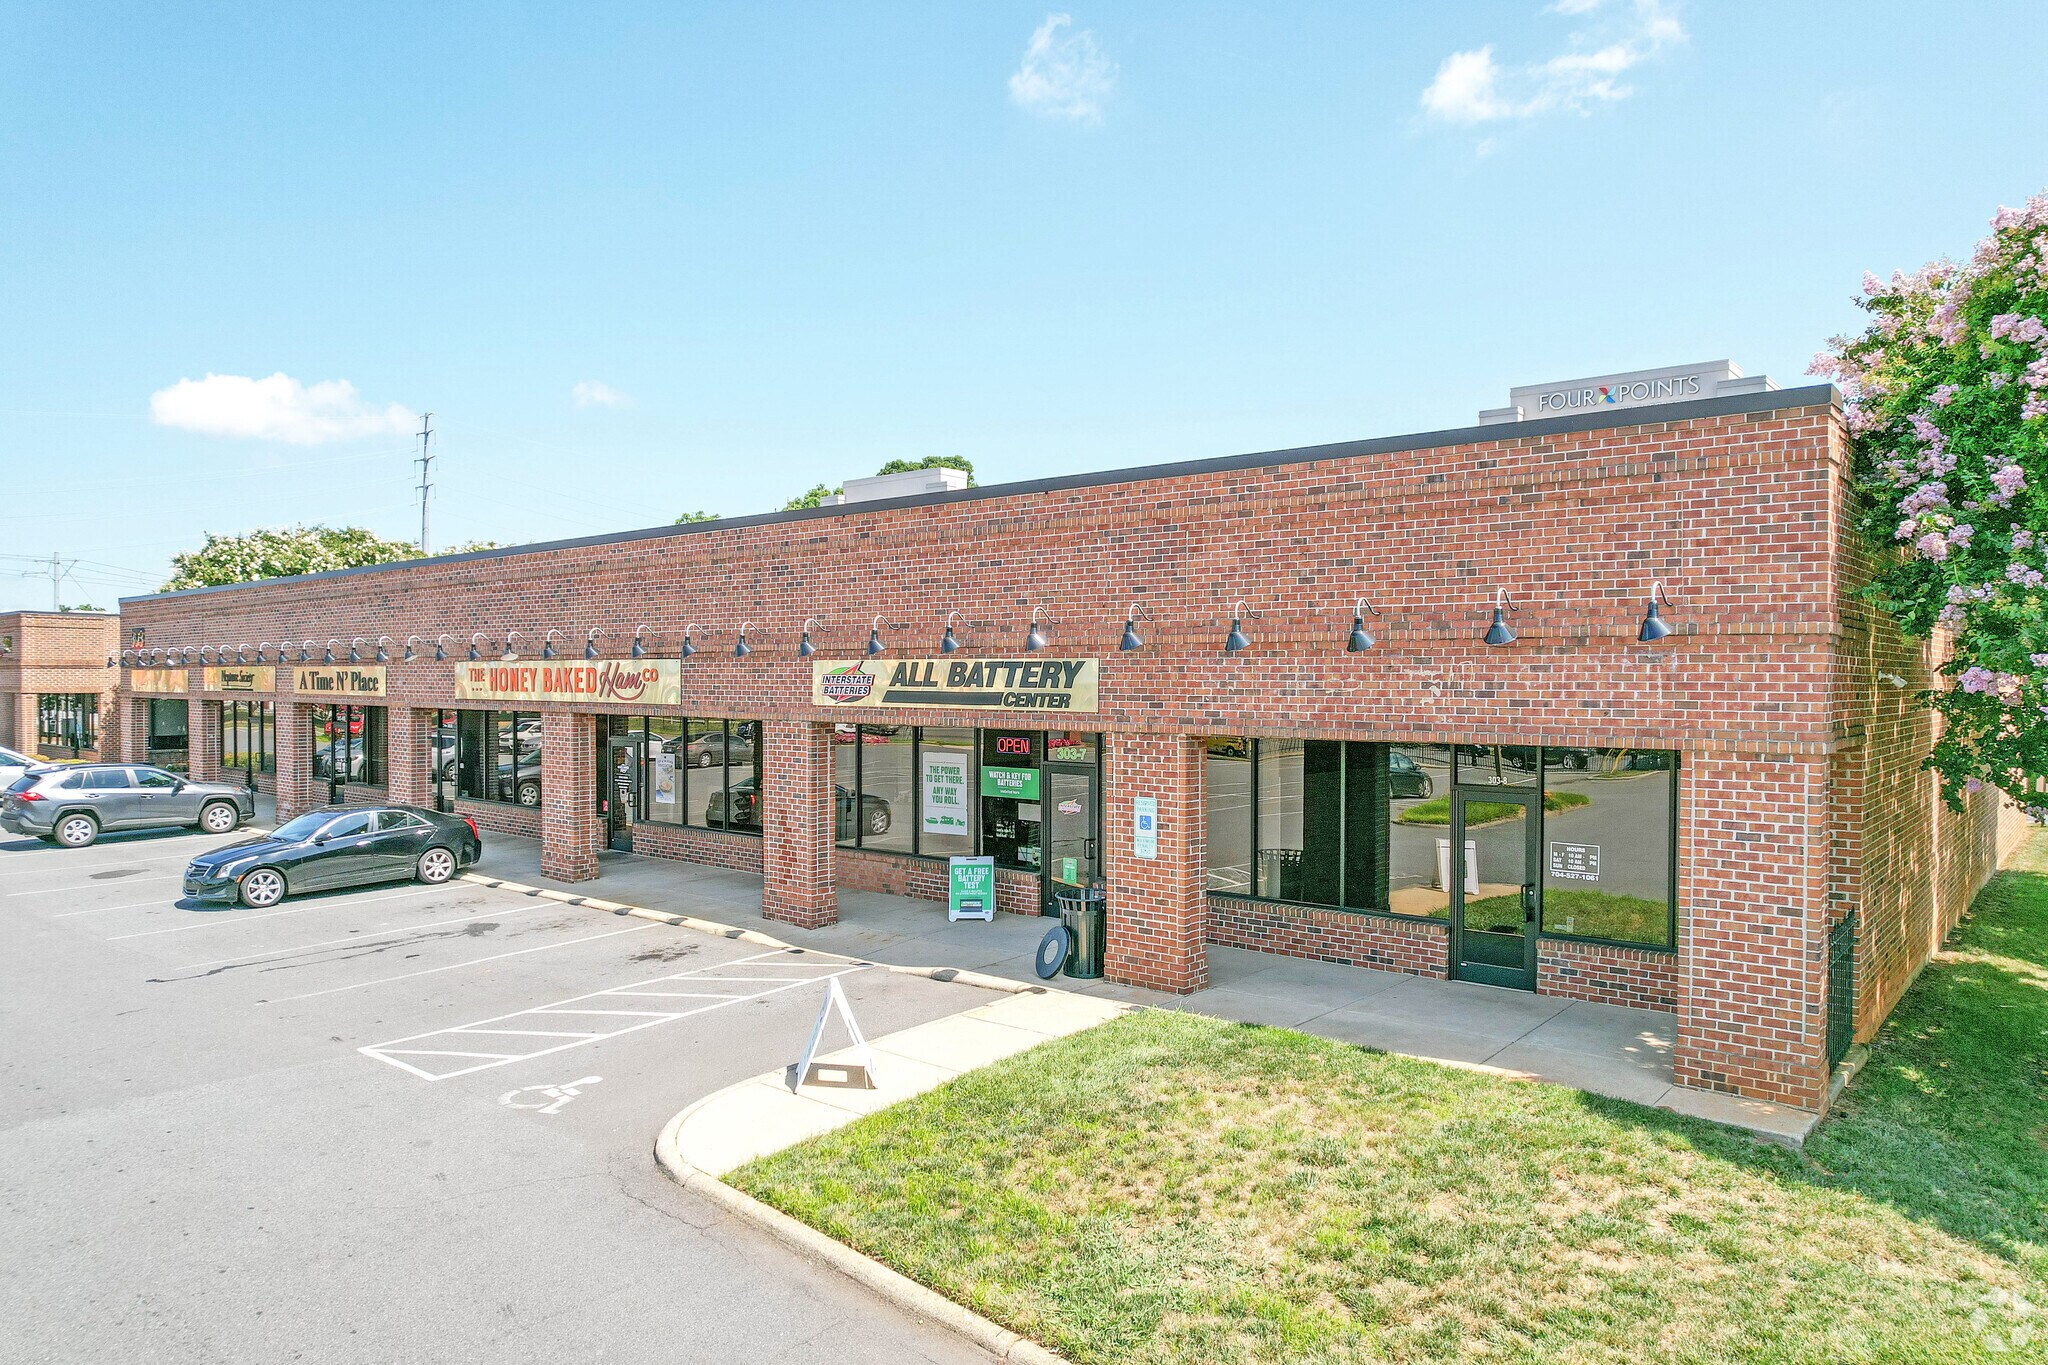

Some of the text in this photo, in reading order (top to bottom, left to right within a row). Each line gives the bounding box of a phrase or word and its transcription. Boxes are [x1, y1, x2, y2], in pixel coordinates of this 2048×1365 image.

[1539, 375, 1700, 412] FOUR POINTS
[822, 675, 872, 684] INTERSTATE
[889, 660, 1086, 689] ALL BATTERY
[299, 671, 308, 690] A
[309, 671, 334, 691] Time
[350, 671, 379, 692] Place
[468, 662, 659, 701] THE HONEY BAKED Ham CO
[823, 686, 868, 695] BATTERIES
[1004, 691, 1072, 709] CENTER
[998, 738, 1029, 753] OPEN
[1057, 747, 1087, 760] 303-7
[930, 765, 961, 775] THE POWER
[989, 771, 1006, 779] WATCH
[926, 774, 965, 785] TO GET THERE.
[997, 779, 1023, 788] BATTERIES
[1488, 776, 1508, 785] 303-8
[933, 786, 957, 796] ANY WAY
[932, 795, 960, 805] YOU ROLL.
[955, 867, 966, 875] GET
[1551, 872, 1599, 881] 704-527-1061
